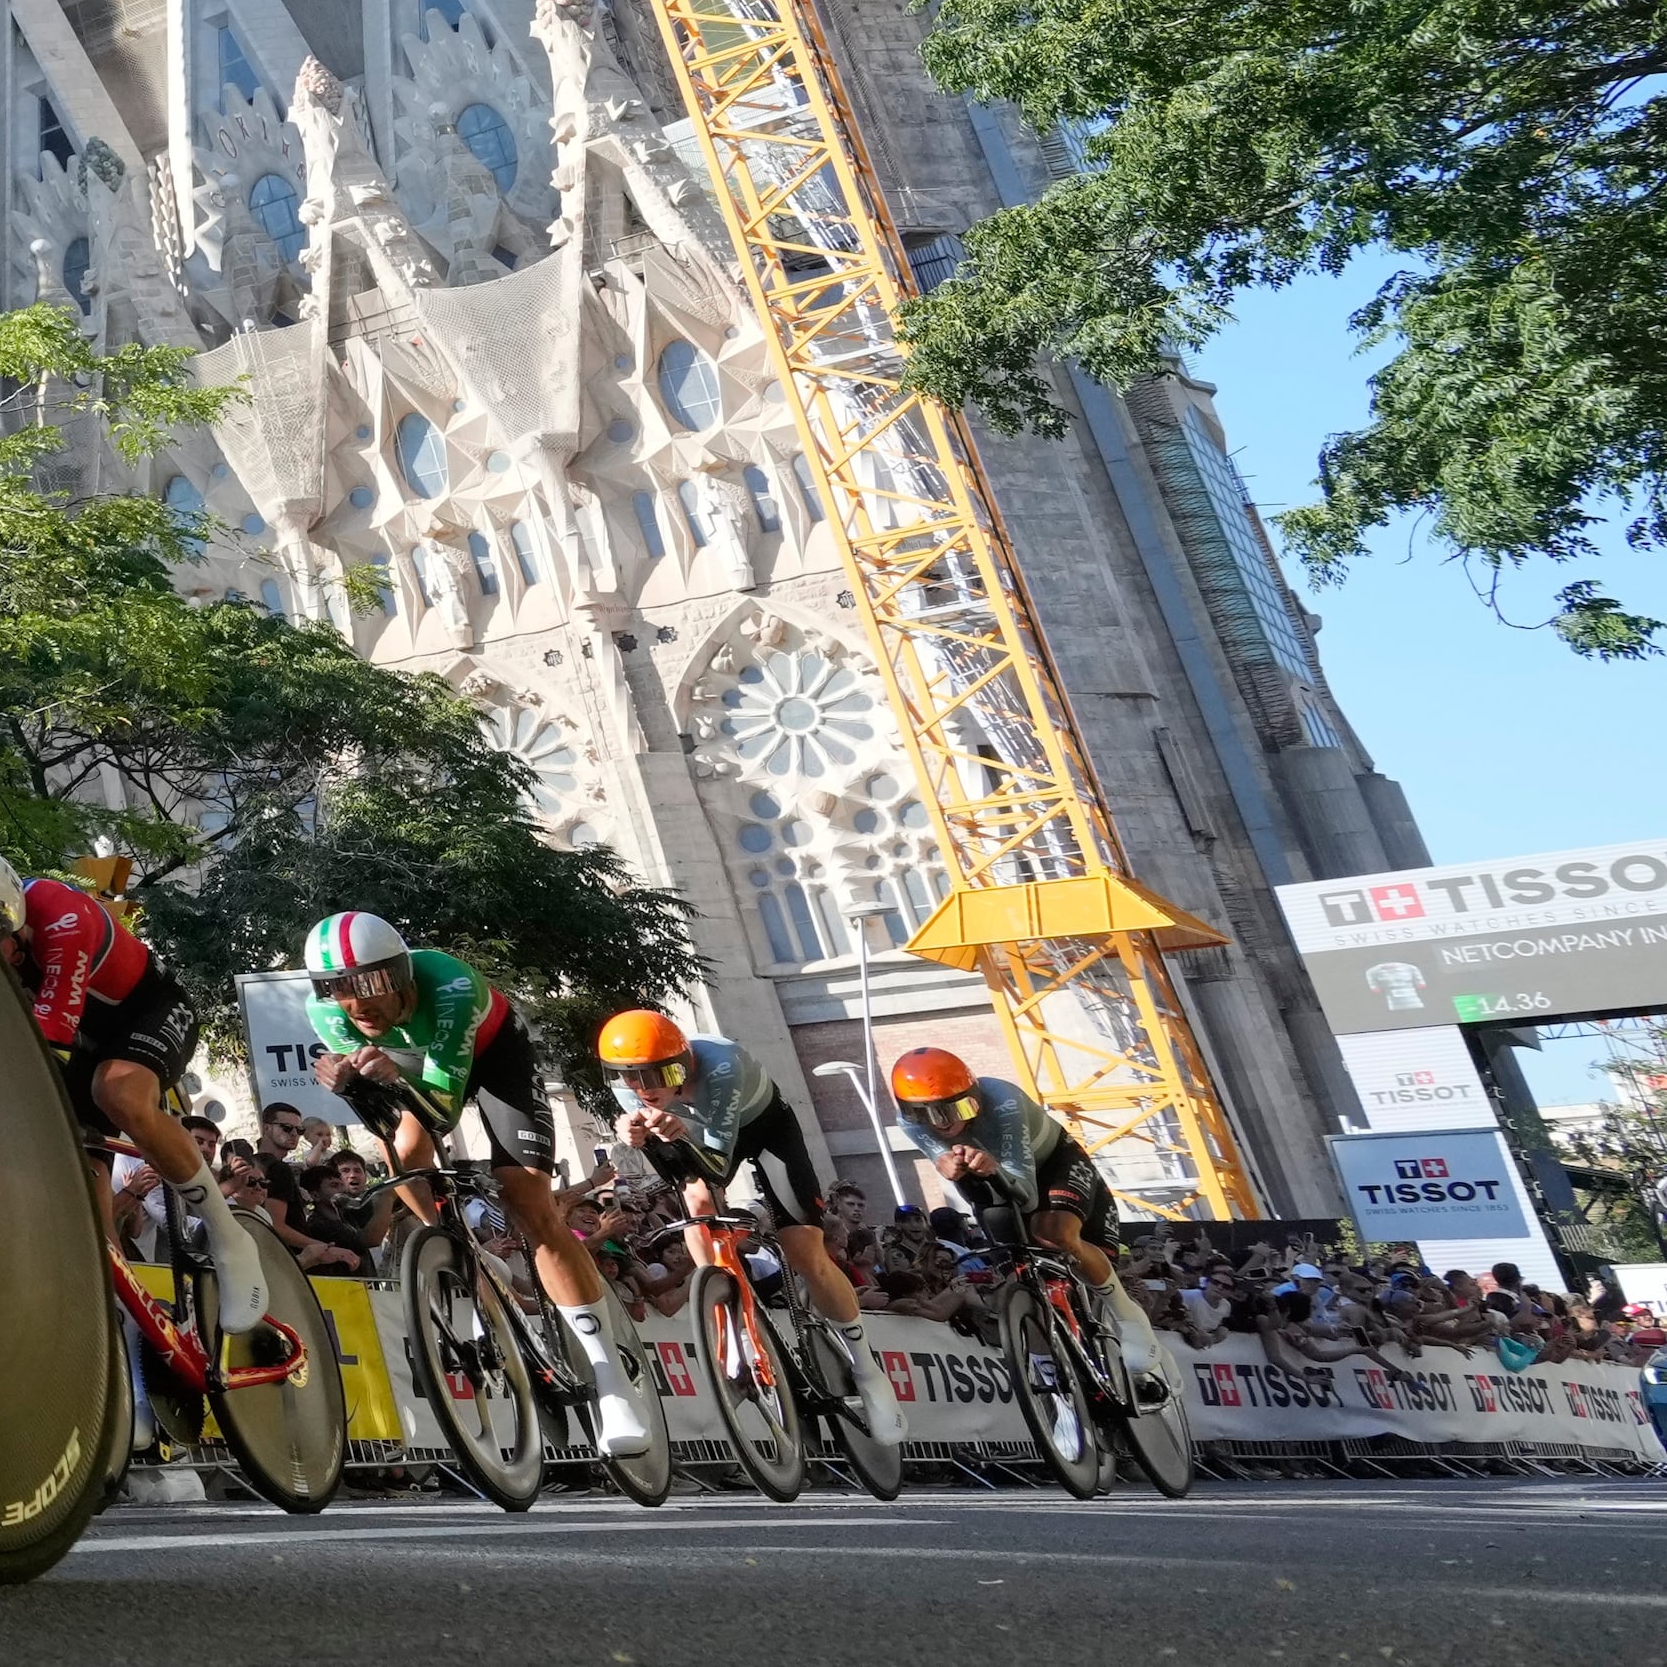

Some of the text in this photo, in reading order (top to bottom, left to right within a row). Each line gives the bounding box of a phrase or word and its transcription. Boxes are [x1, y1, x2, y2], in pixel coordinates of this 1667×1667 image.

[1427, 852, 1667, 913] TISSO
[1334, 900, 1660, 947] SWISS WATCHES SINCE
[1440, 930, 1634, 966] NETCOMPANY
[42, 947, 64, 1000] INEOS
[68, 949, 89, 1006] wtw
[431, 997, 455, 1053] INEOS
[266, 1043, 329, 1072] TIS
[270, 1077, 307, 1088] SWISS
[1369, 1084, 1471, 1105] TISSOT
[720, 1088, 742, 1129] wtw
[1358, 1180, 1500, 1205] TISSOT
[1399, 1206, 1448, 1215] WATCHES
[1235, 1364, 1345, 1408] TISSOT
[1488, 1375, 1556, 1415] TISSOT
[1579, 1383, 1628, 1424] TISSOT
